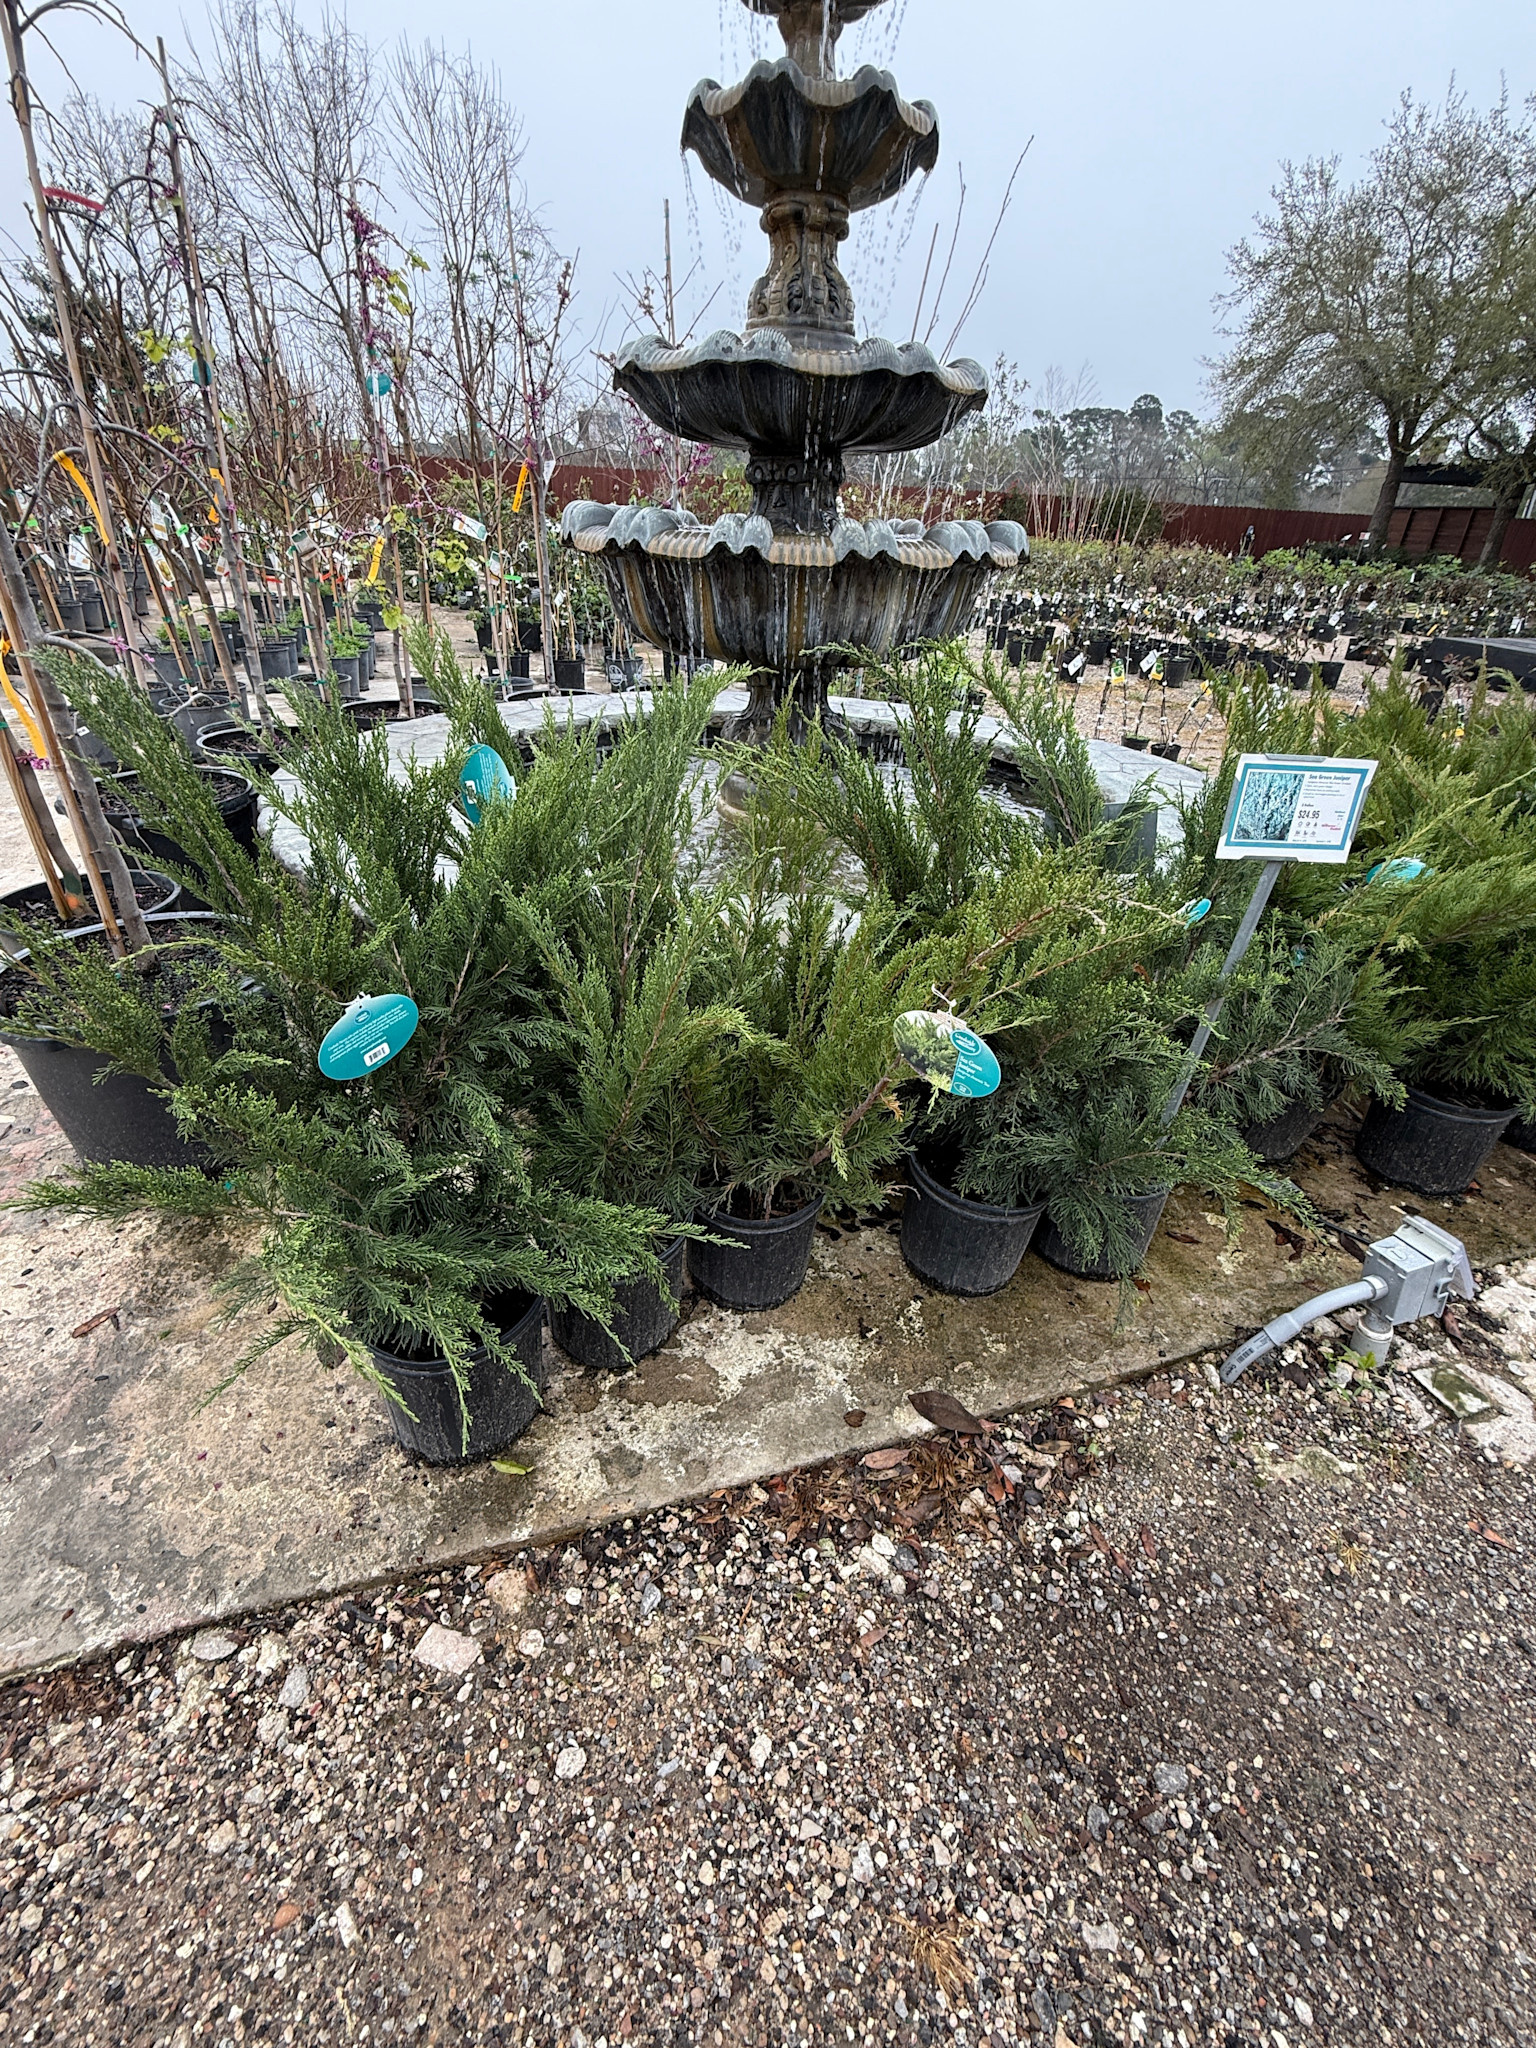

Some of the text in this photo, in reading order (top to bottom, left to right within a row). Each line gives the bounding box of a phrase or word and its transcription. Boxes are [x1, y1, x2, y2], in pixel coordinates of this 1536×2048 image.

[1298, 810, 1320, 818] $24.95
[958, 1062, 975, 1074] Juniper
[968, 1060, 982, 1071] Green
